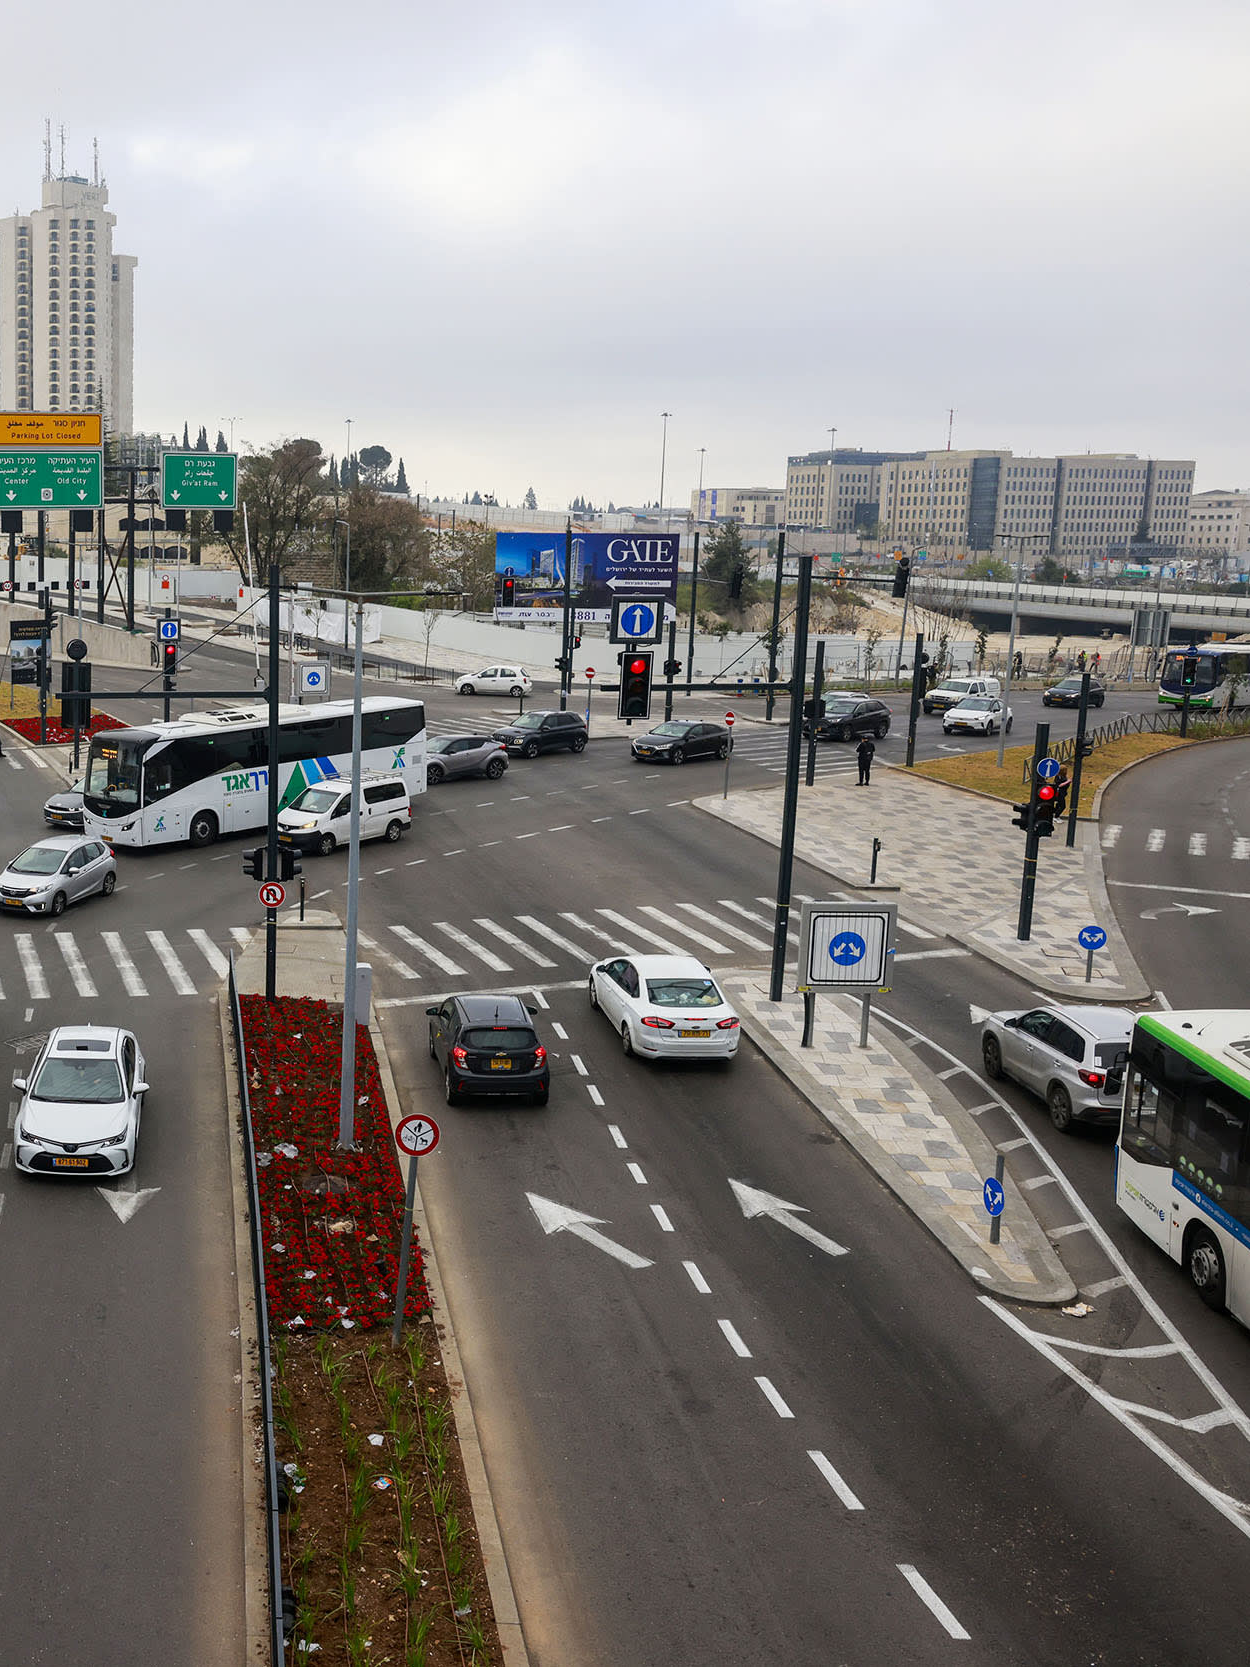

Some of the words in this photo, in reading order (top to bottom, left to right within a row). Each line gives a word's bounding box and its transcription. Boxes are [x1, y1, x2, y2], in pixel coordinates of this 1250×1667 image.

[53, 419, 68, 427] סגור
[71, 420, 86, 428] חניון
[11, 432, 39, 440] Parking
[17, 457, 36, 465] מרכז
[47, 457, 76, 466] העתיקה
[79, 457, 96, 465] העיר
[72, 477, 87, 485] City
[606, 538, 674, 563] GATE
[574, 611, 596, 621] 881
